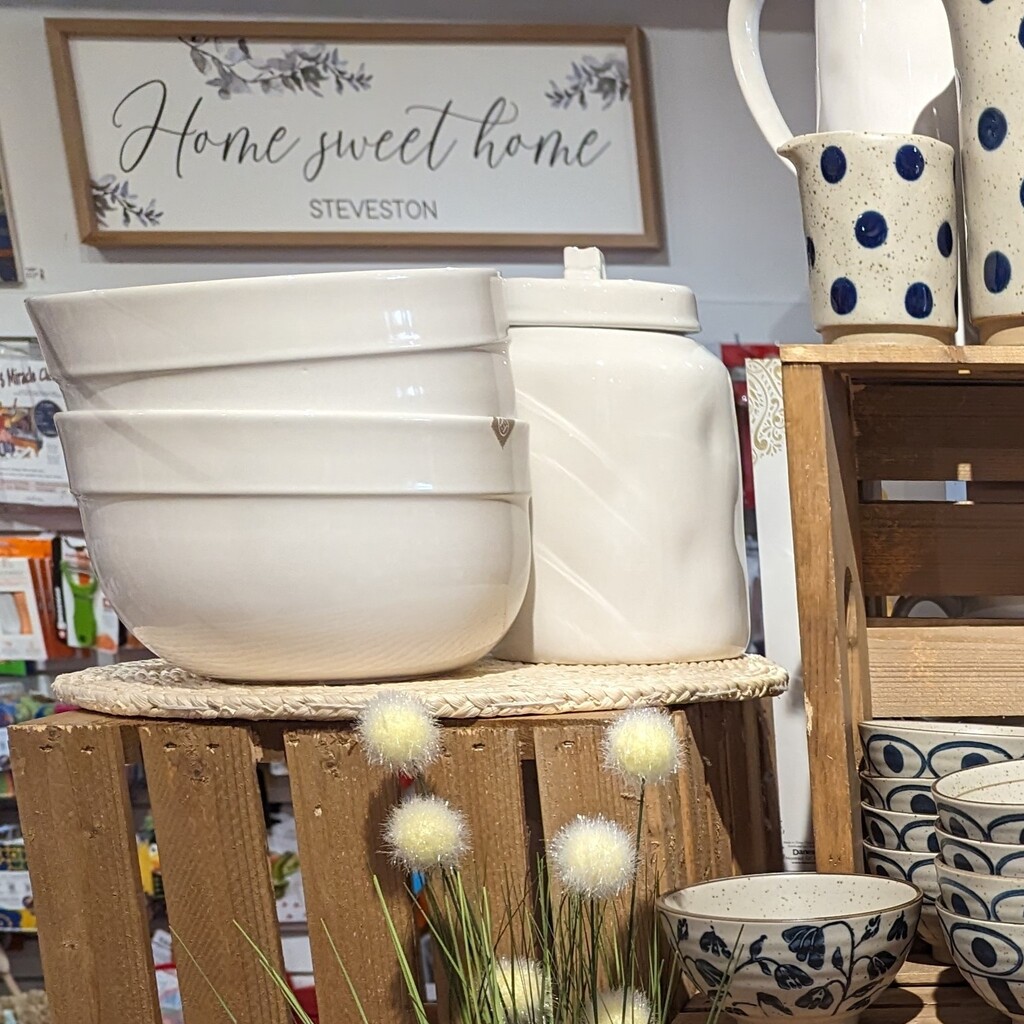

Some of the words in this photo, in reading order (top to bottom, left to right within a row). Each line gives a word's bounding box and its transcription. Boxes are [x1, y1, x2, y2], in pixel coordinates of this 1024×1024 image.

[112, 79, 300, 179] Home
[303, 99, 458, 182] sweet
[473, 96, 611, 169] home
[309, 199, 439, 220] STEVESTON
